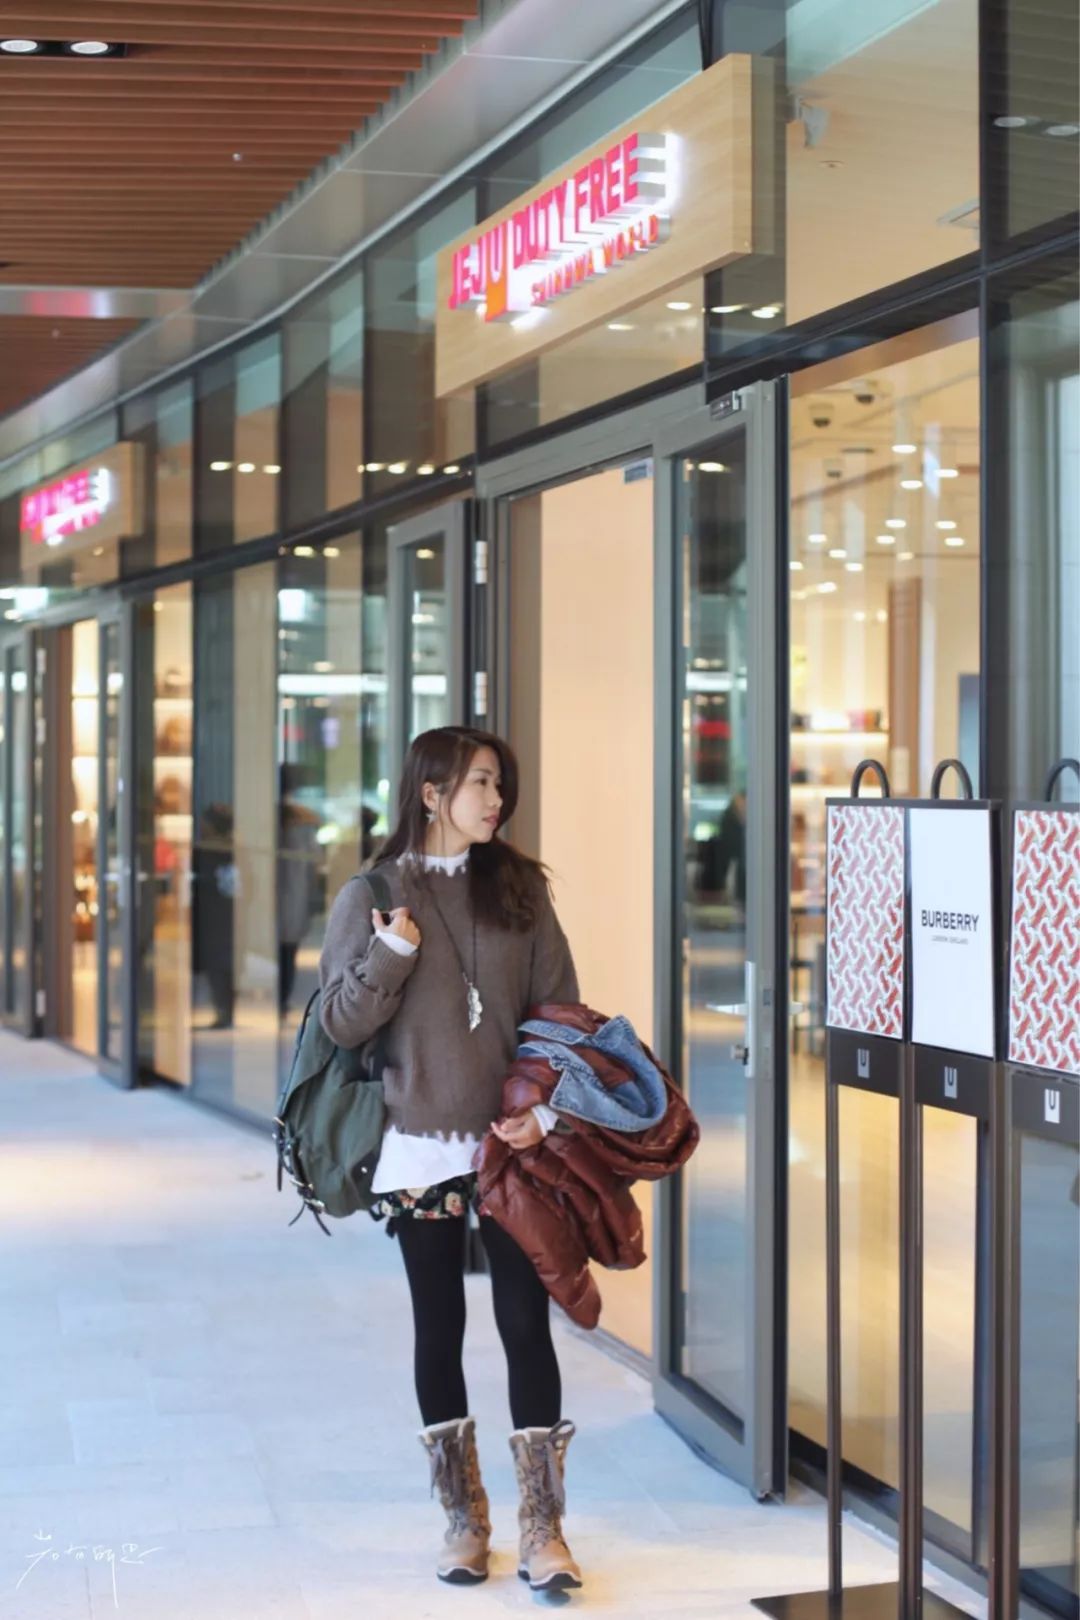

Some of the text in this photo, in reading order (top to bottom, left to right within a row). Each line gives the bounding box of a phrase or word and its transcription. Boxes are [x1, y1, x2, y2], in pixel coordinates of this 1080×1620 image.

[448, 221, 507, 323] JEJU
[513, 180, 567, 270] DUTY
[574, 132, 638, 234] FREE
[921, 909, 979, 932] BURBERRY
